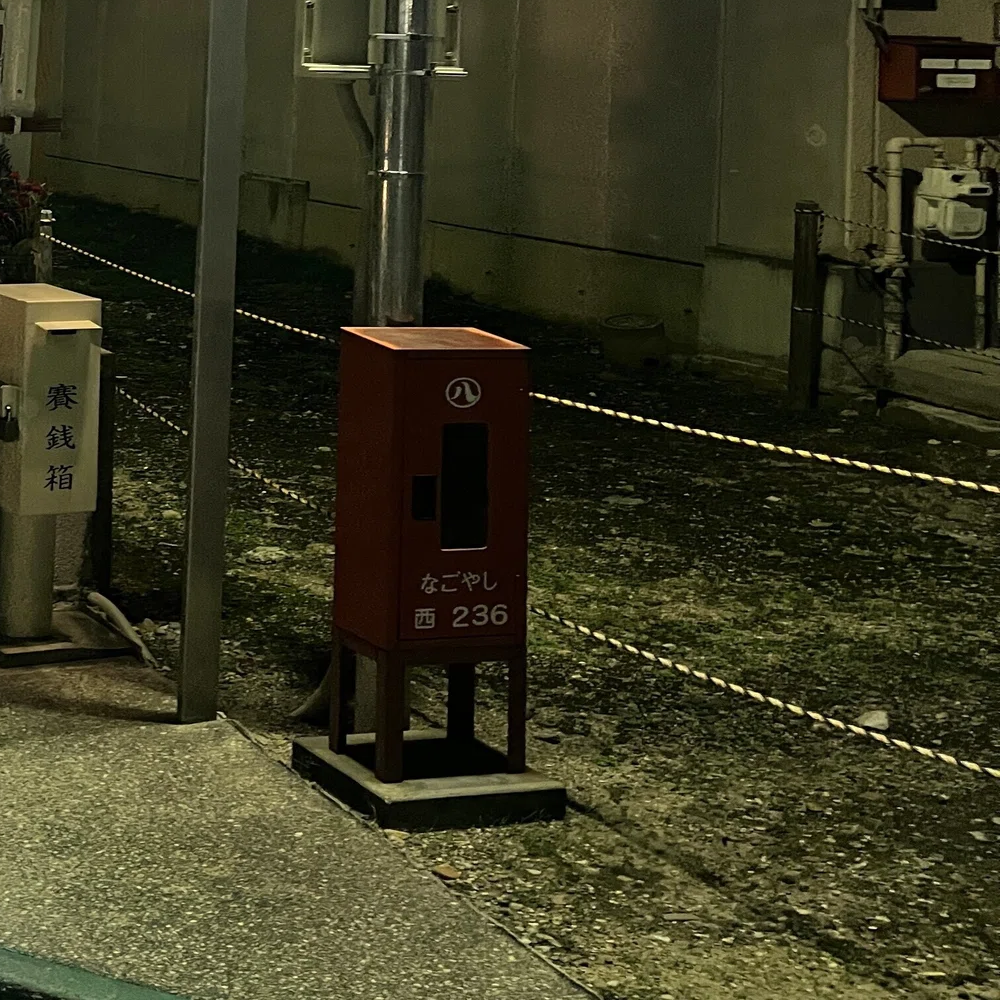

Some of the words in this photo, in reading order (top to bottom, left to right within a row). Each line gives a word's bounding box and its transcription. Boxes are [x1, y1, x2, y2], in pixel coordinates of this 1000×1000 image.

[45, 384, 79, 491] 賽銭箱
[421, 571, 497, 594] なごやし
[415, 608, 436, 629] 西
[452, 604, 509, 628] 236
